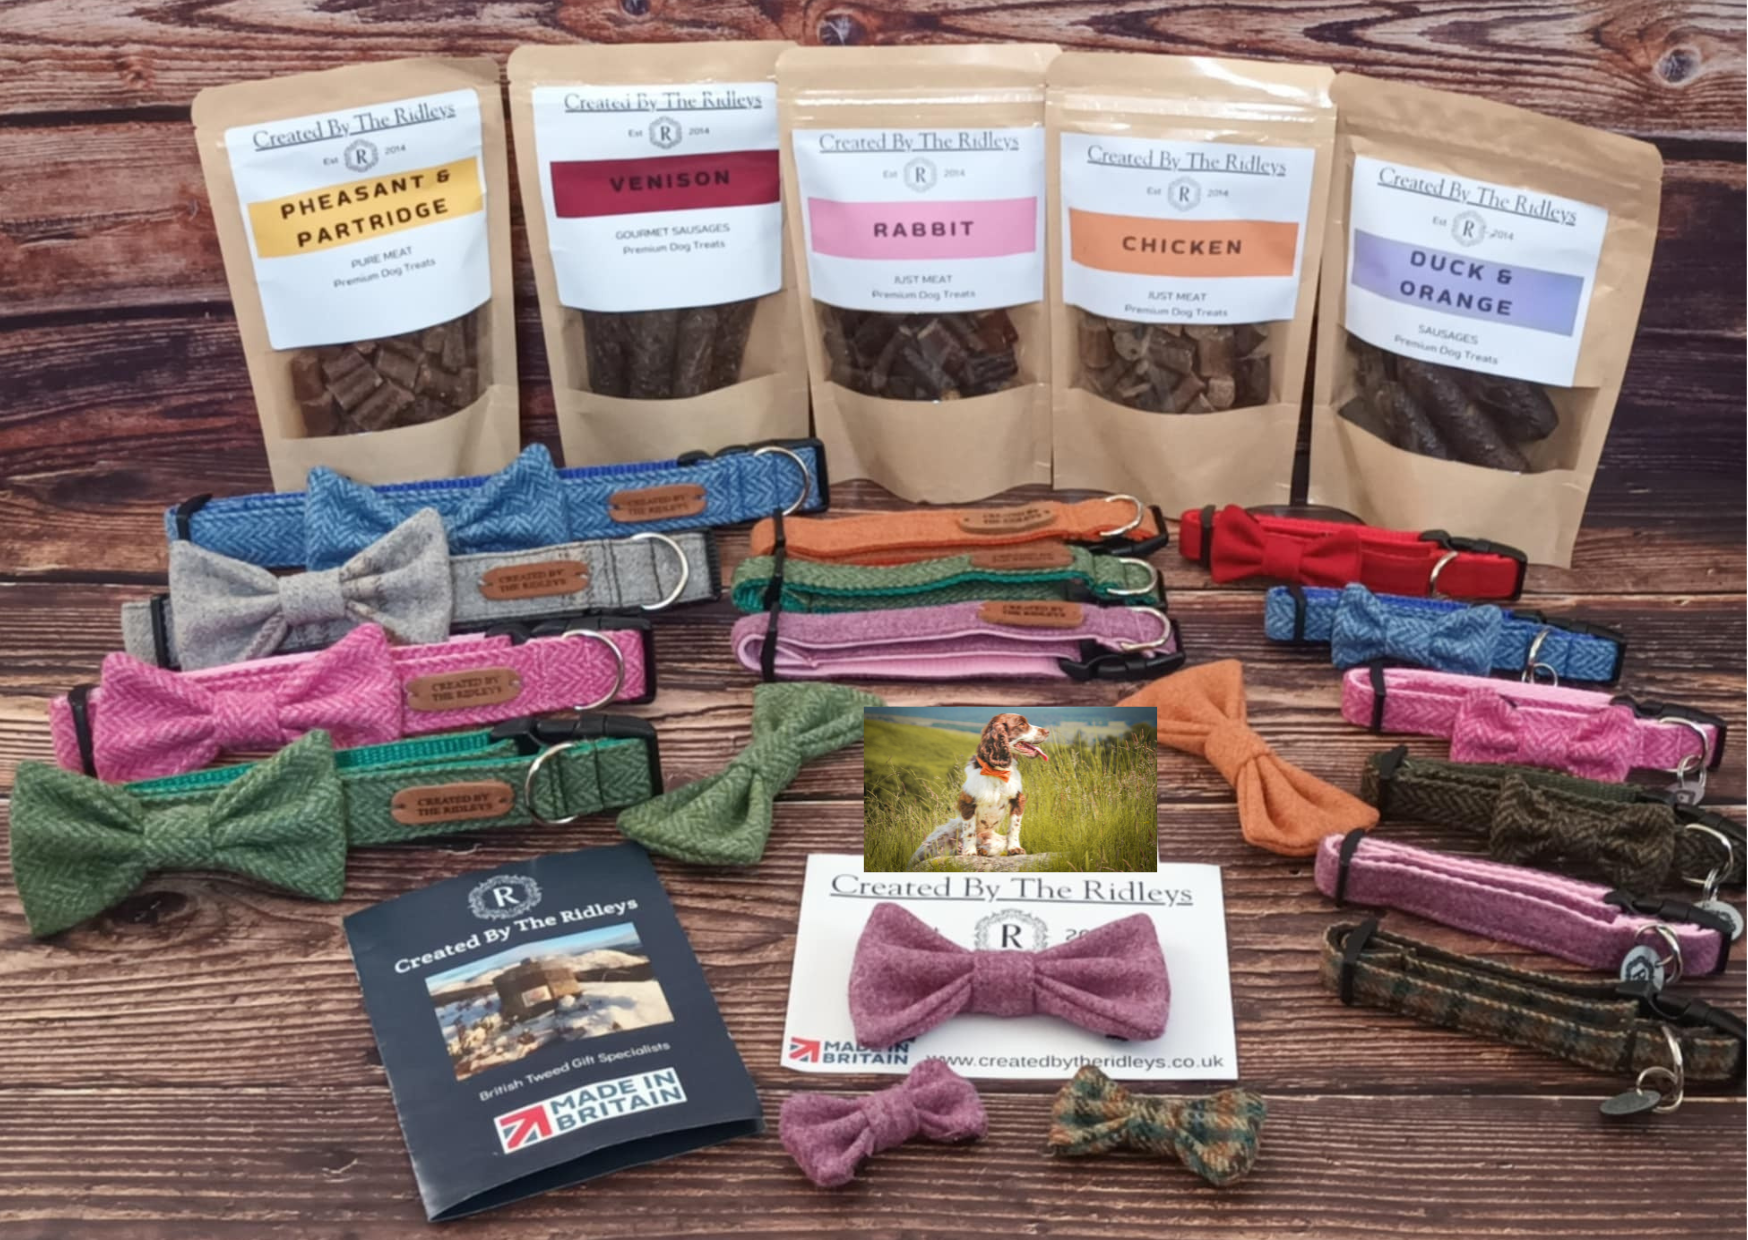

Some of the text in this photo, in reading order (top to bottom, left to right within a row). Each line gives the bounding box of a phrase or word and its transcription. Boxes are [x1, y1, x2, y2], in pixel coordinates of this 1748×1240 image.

[564, 90, 762, 112] Created By The Ridleys
[252, 102, 456, 149] Created By The Ridleys
[628, 129, 643, 138] Est
[688, 126, 710, 136] 2014
[819, 131, 1019, 152] Created By The Ridleys
[323, 156, 339, 166] Est
[384, 144, 406, 156] 2014
[1087, 144, 1286, 176] Created By The Ridleys
[609, 169, 730, 193] VENISON
[882, 170, 898, 179] Est
[943, 169, 966, 178] 2014
[280, 169, 451, 220] PHEASANT &
[1146, 186, 1161, 196] Est
[1207, 188, 1229, 198] 2014
[1379, 167, 1577, 225] Created By The Ridleys
[296, 198, 449, 247] PARTRIDGE
[615, 223, 731, 241] GOURMET SAUSAGES
[873, 221, 974, 238] RABBIT
[1432, 216, 1447, 227] Est
[622, 239, 726, 256] Premium Dog Treats
[1122, 235, 1242, 255] CHICKEN
[351, 246, 413, 269] PURE MEAT
[1410, 250, 1513, 285] DUCK &
[333, 258, 436, 288] Premium Dog Treats
[894, 274, 952, 285] JUST MEAT
[871, 288, 976, 301] Premium Dog Treats
[1148, 291, 1207, 302] JUST MEAT
[1400, 280, 1513, 316] ORANGE
[1125, 304, 1228, 319] Premium Dog Treats
[1418, 324, 1479, 345] SAUSAGES
[1394, 335, 1498, 365] Premium Dog Treats
[432, 676, 500, 691] CREATED BY
[432, 686, 502, 701] THE RIDLEYS
[417, 793, 489, 806] CREATED BY
[417, 803, 493, 816] THE RIDLEYS
[493, 886, 520, 907] R
[831, 874, 1193, 905] Created By The Ridleys
[394, 898, 638, 974] Created By The Ridleys
[1002, 924, 1022, 949] R
[822, 1053, 908, 1065] BRITAIN
[926, 1054, 1224, 1071] ww.createdbytheridleys.co.uk
[479, 1042, 671, 1101] British Tweed Gift Specialists
[550, 1069, 675, 1114] MADE IN
[555, 1086, 682, 1131] BRITAIN
